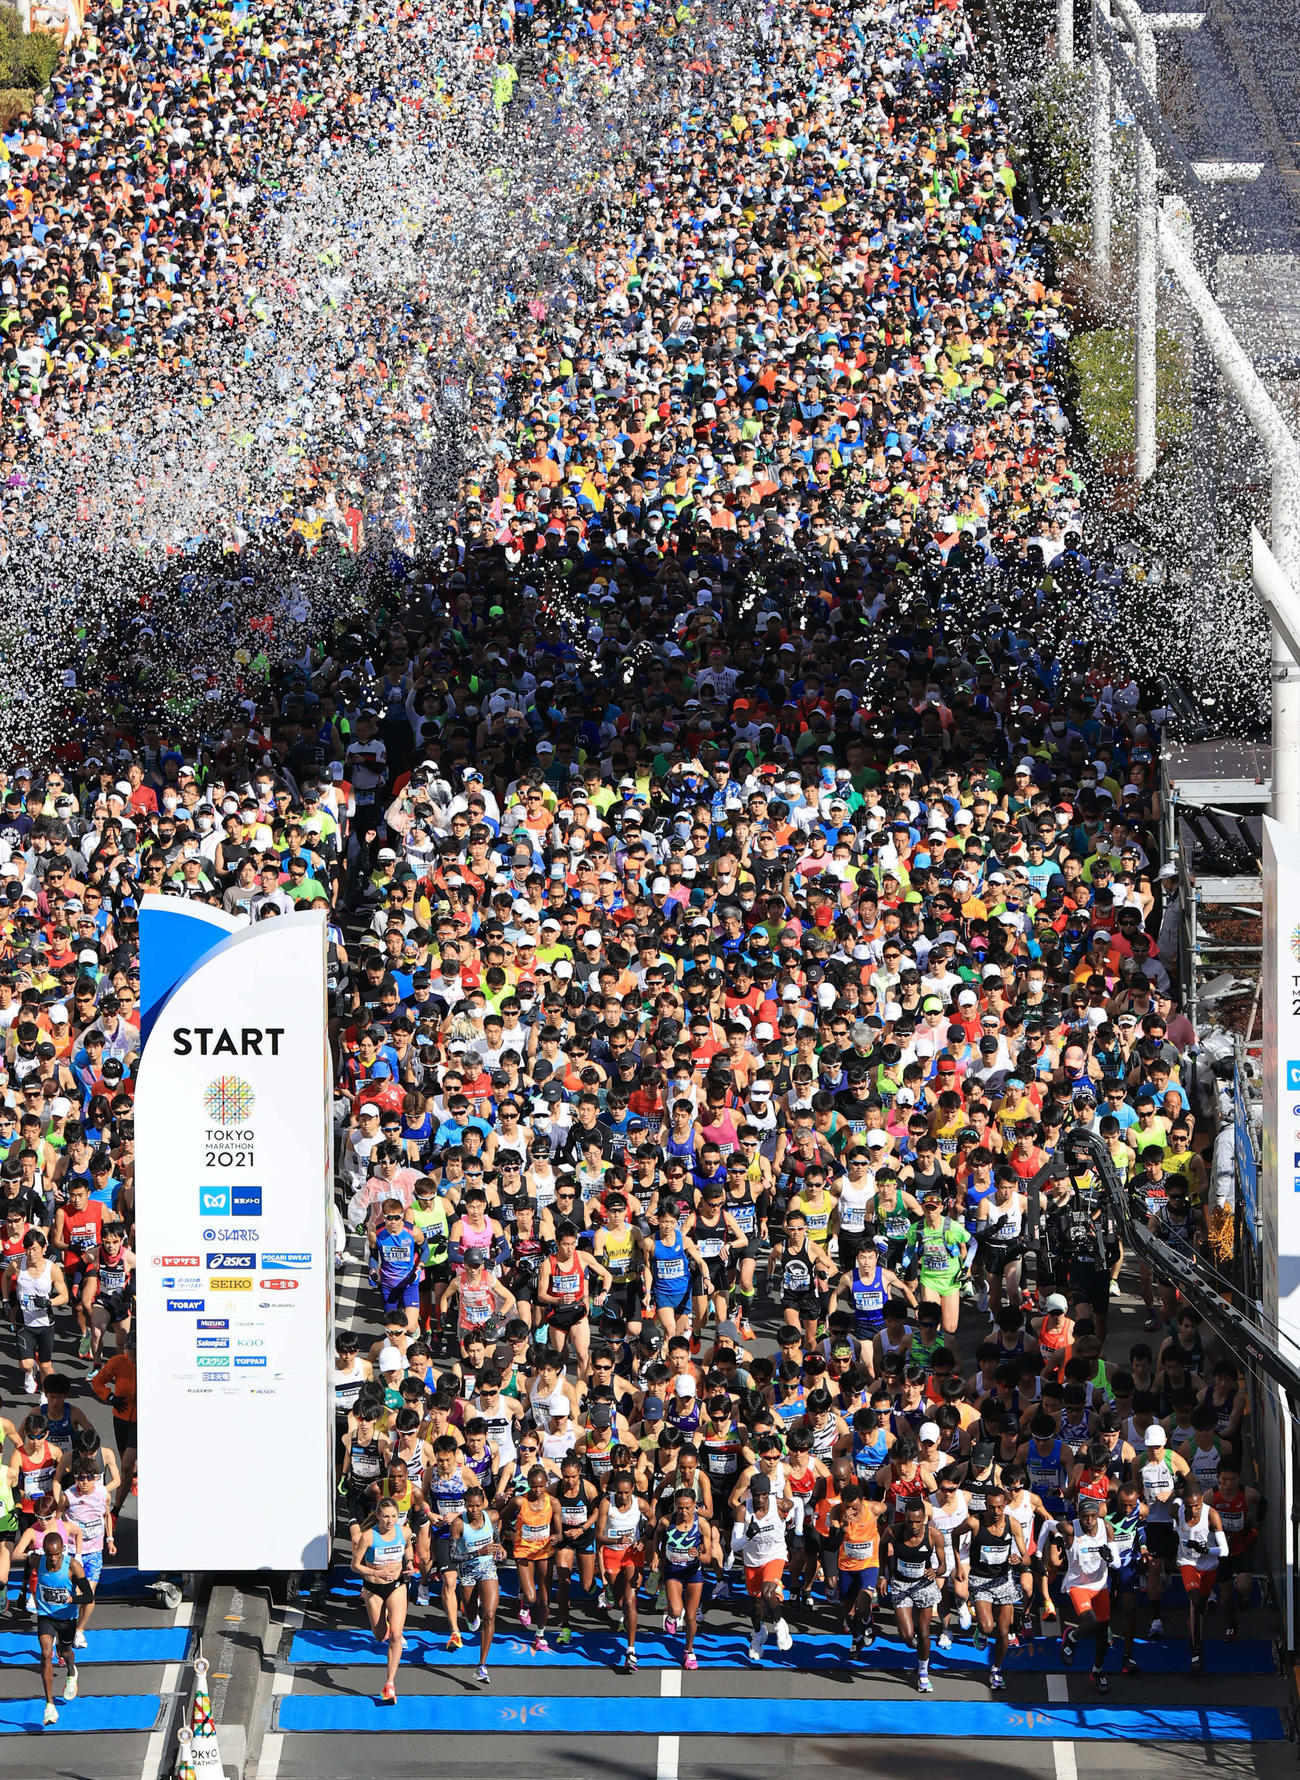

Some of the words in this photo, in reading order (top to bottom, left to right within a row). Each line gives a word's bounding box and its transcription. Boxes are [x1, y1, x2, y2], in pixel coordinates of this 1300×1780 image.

[173, 1027, 285, 1056] START
[205, 1130, 254, 1141] TOKYO
[205, 1142, 254, 1150] MARATHON
[205, 1151, 254, 1167] 2021
[217, 1229, 259, 1241] STARTS
[163, 1257, 199, 1266] ヤマザキ
[211, 1280, 252, 1289] SEIKO
[197, 1357, 229, 1366] バスクリン
[191, 1748, 218, 1759] OKYO
[192, 1759, 218, 1767] RATHON
